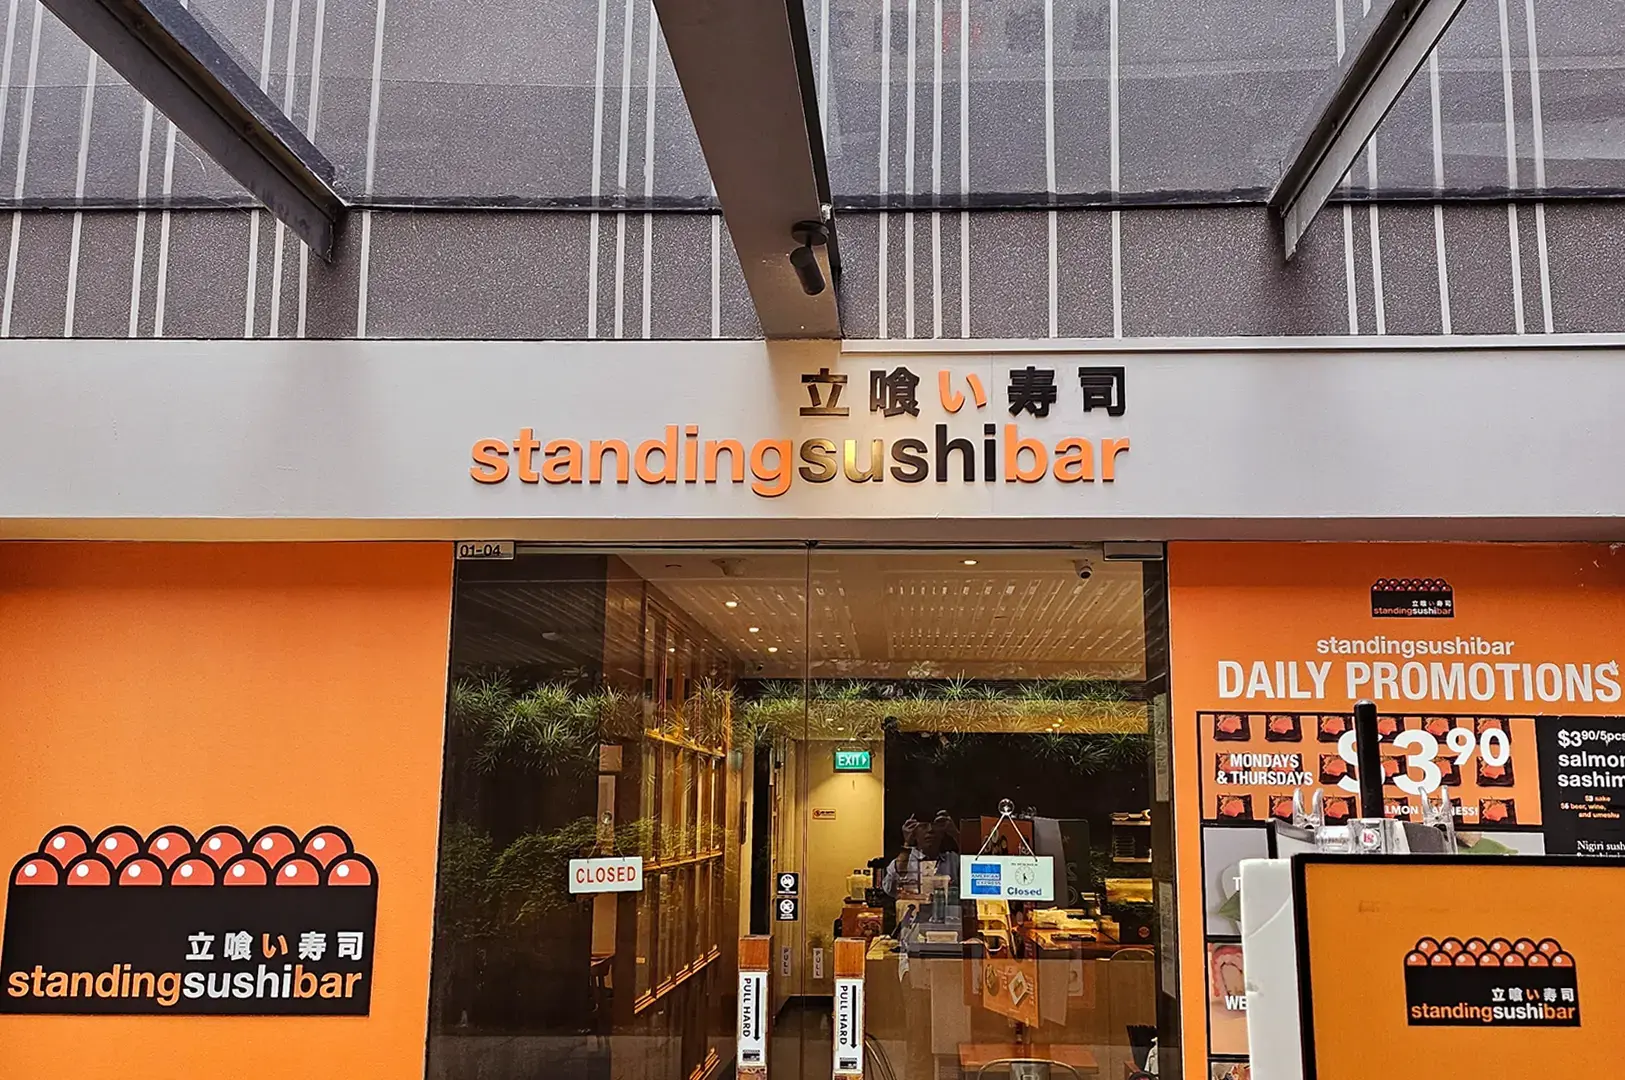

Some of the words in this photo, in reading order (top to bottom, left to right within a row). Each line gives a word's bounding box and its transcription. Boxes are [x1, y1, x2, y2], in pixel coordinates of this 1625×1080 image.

[799, 365, 1127, 418] 立喰い寿司
[469, 424, 1130, 498] standingsushibar
[460, 544, 501, 557] 01-04
[1373, 606, 1452, 616] standingsushibar
[1316, 635, 1515, 659] standingsushibar
[1217, 660, 1332, 699] DAILY
[1346, 660, 1622, 703] PROMOTIONS
[837, 752, 860, 766] EXIT
[1230, 753, 1299, 769] MONDAYS
[1216, 770, 1228, 785] &
[1230, 770, 1314, 786] THURSDAYS
[1577, 840, 1604, 852] Nigiri
[575, 865, 636, 884] CLOSED
[1007, 886, 1042, 896] Closed
[185, 931, 364, 961] 立喰い寿司
[7, 964, 362, 1007] standingsushibar
[743, 977, 752, 1003] PULL
[840, 985, 848, 1011] PULL
[742, 1006, 751, 1038] HARD
[1411, 1002, 1576, 1023] standingsushibar
[839, 1014, 848, 1046] HARD
